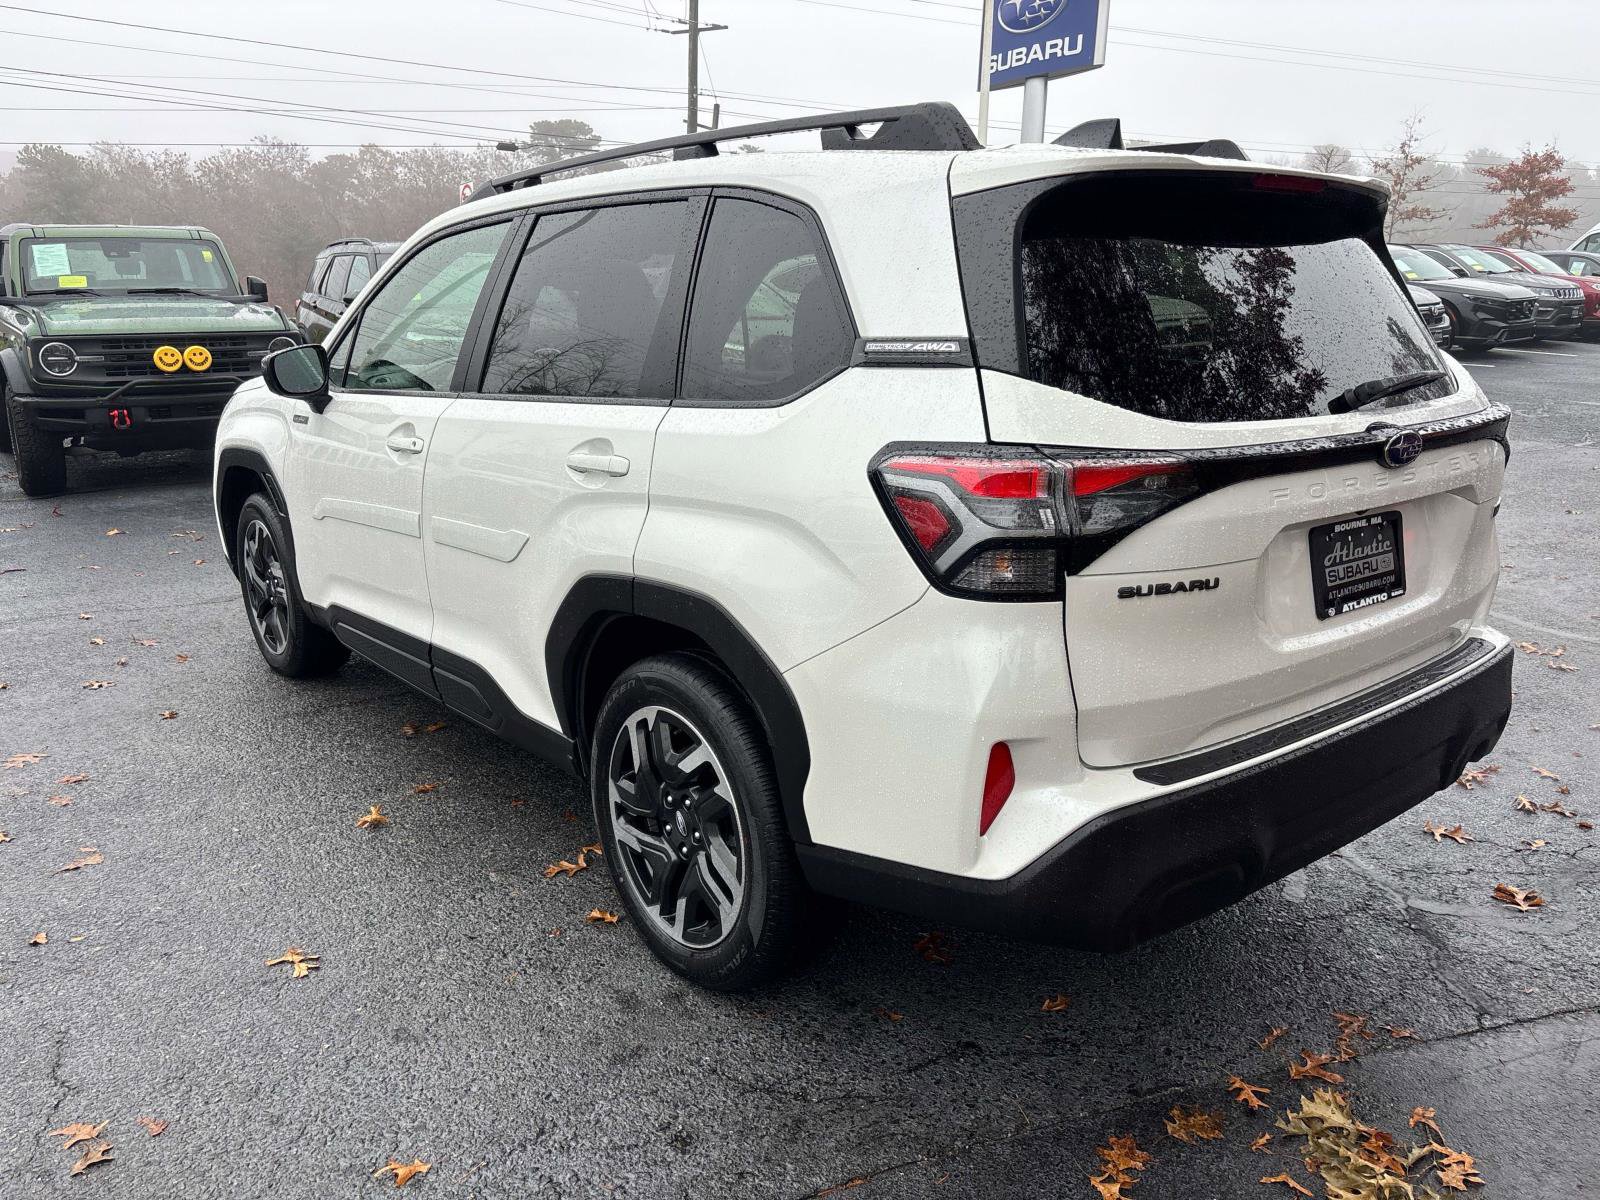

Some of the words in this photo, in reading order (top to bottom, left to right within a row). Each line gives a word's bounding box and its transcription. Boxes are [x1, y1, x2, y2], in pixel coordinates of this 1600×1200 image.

[989, 34, 1084, 74] SUBARU
[910, 342, 956, 352] AWD
[1269, 452, 1480, 508] FORESTER
[1370, 516, 1383, 525] MA
[1323, 538, 1393, 567] Atlantic
[1327, 558, 1379, 584] SUBARU
[1117, 577, 1220, 599] SUBARU
